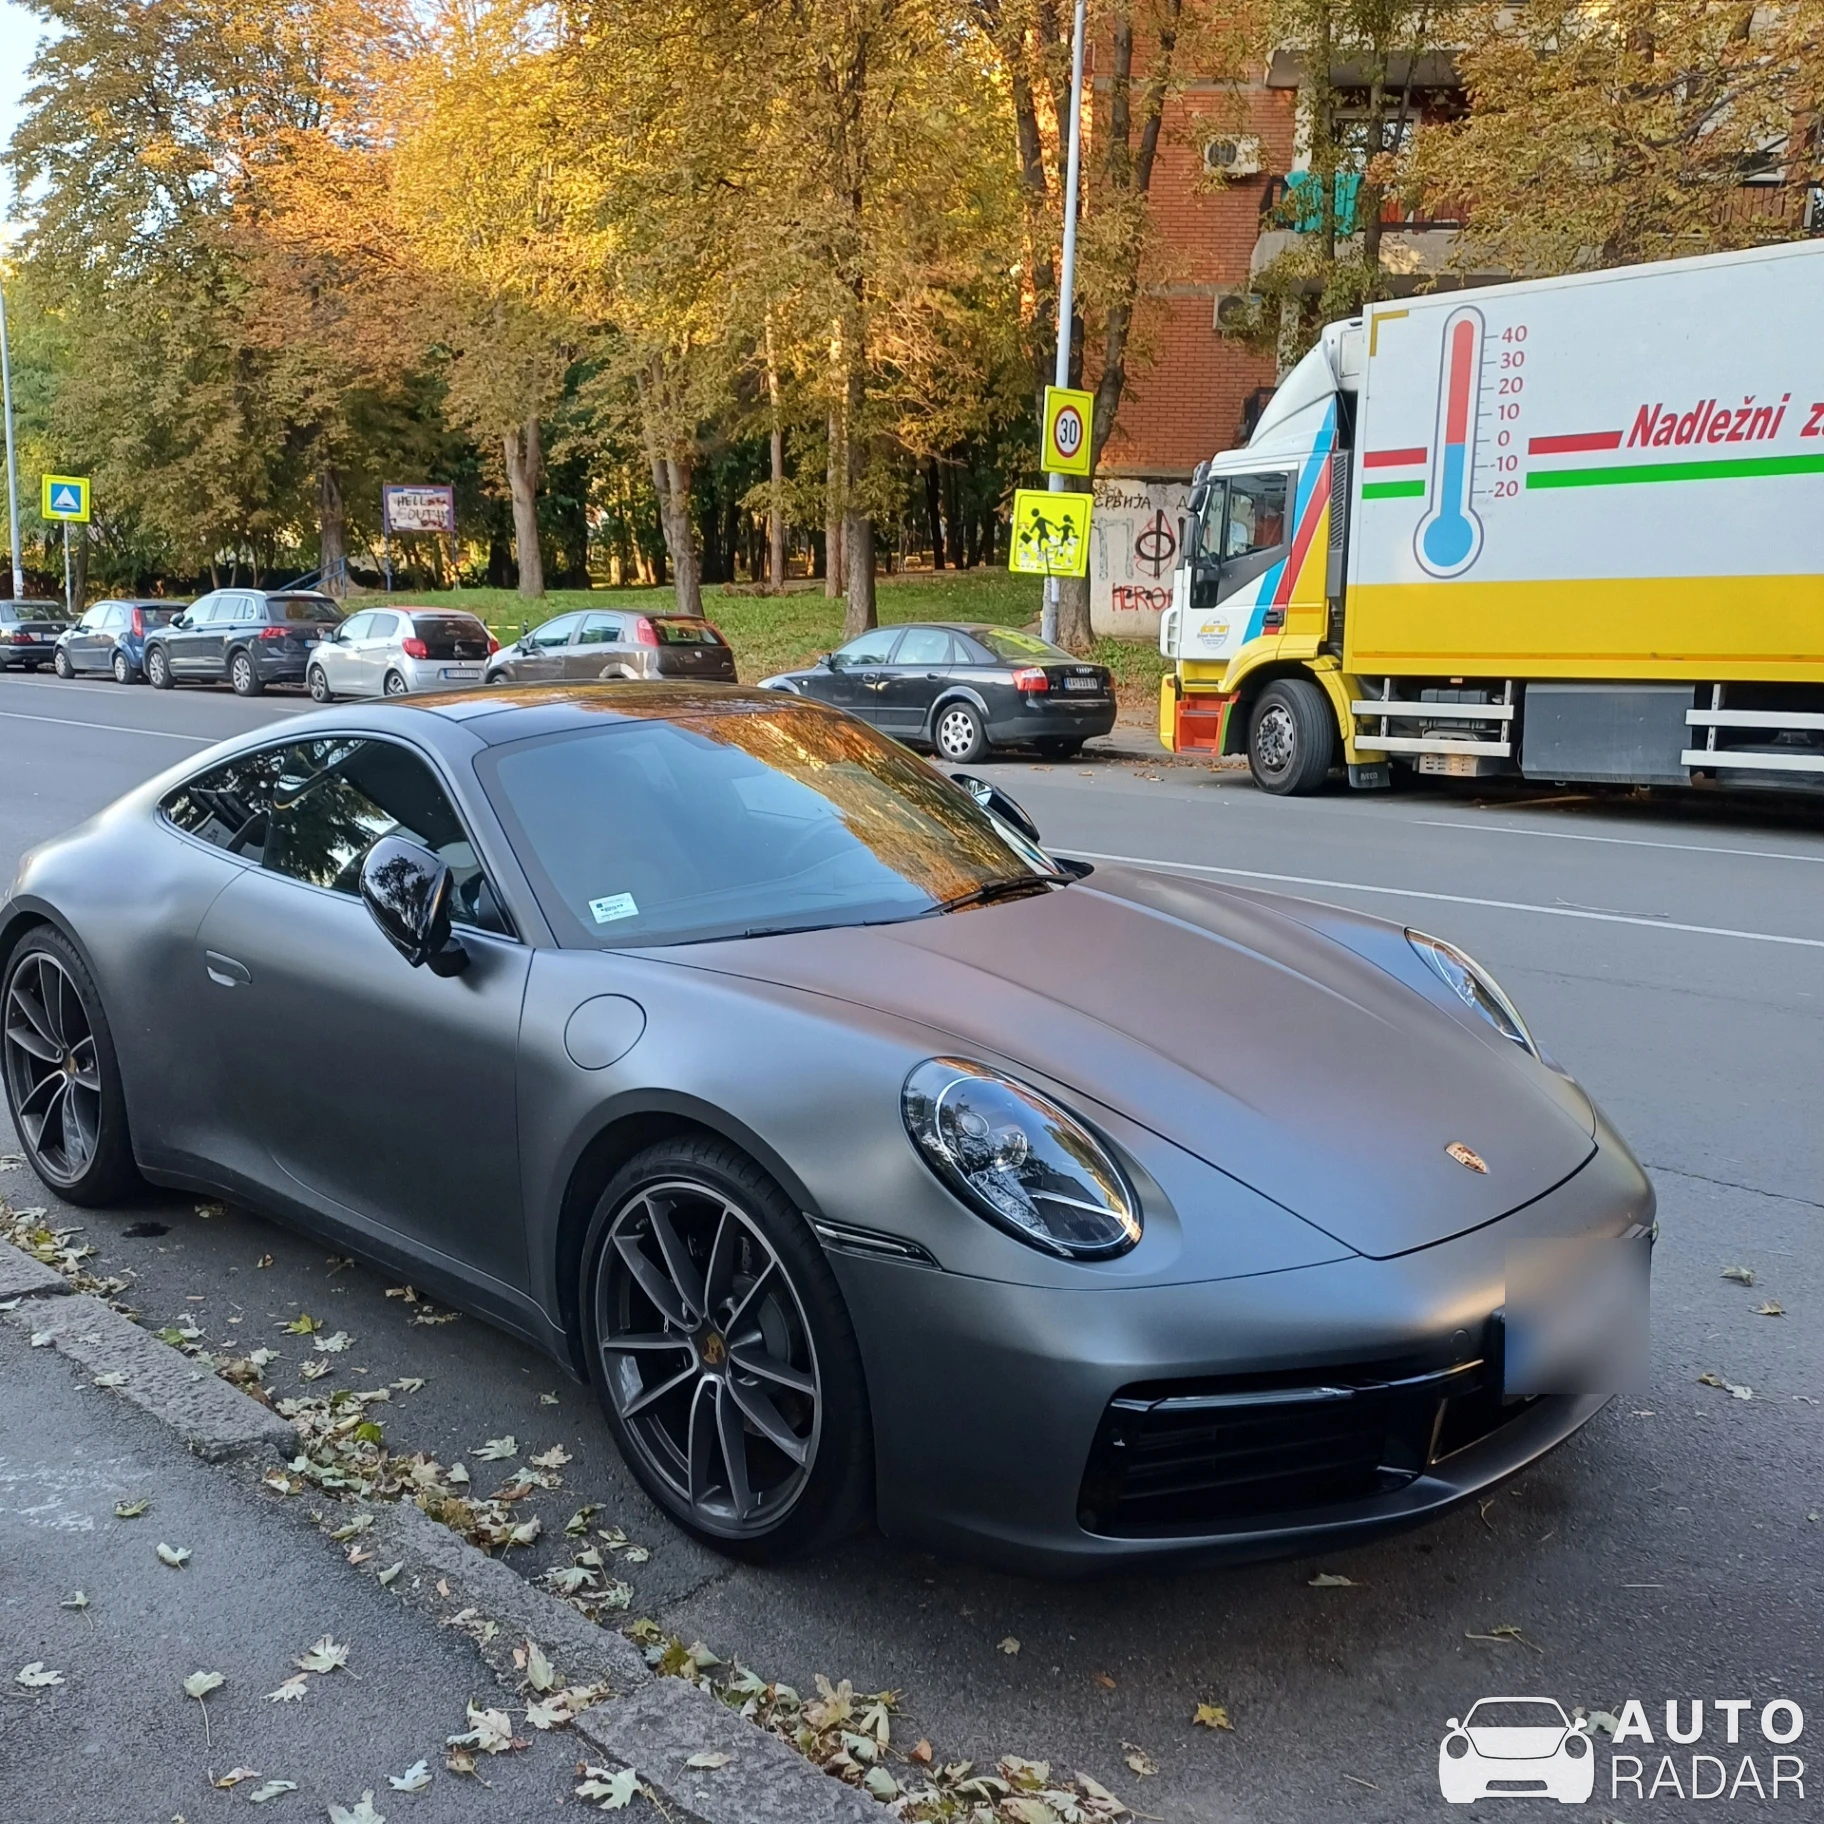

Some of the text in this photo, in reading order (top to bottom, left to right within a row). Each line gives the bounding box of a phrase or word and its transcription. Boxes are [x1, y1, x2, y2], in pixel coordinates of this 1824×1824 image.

[1501, 325, 1528, 344] 40
[1500, 351, 1525, 369] 30
[1498, 376, 1523, 395] 20
[1498, 403, 1520, 420] 10
[1627, 392, 1824, 448] Nadležni z
[1059, 418, 1078, 445] 30
[1497, 430, 1510, 447] 0
